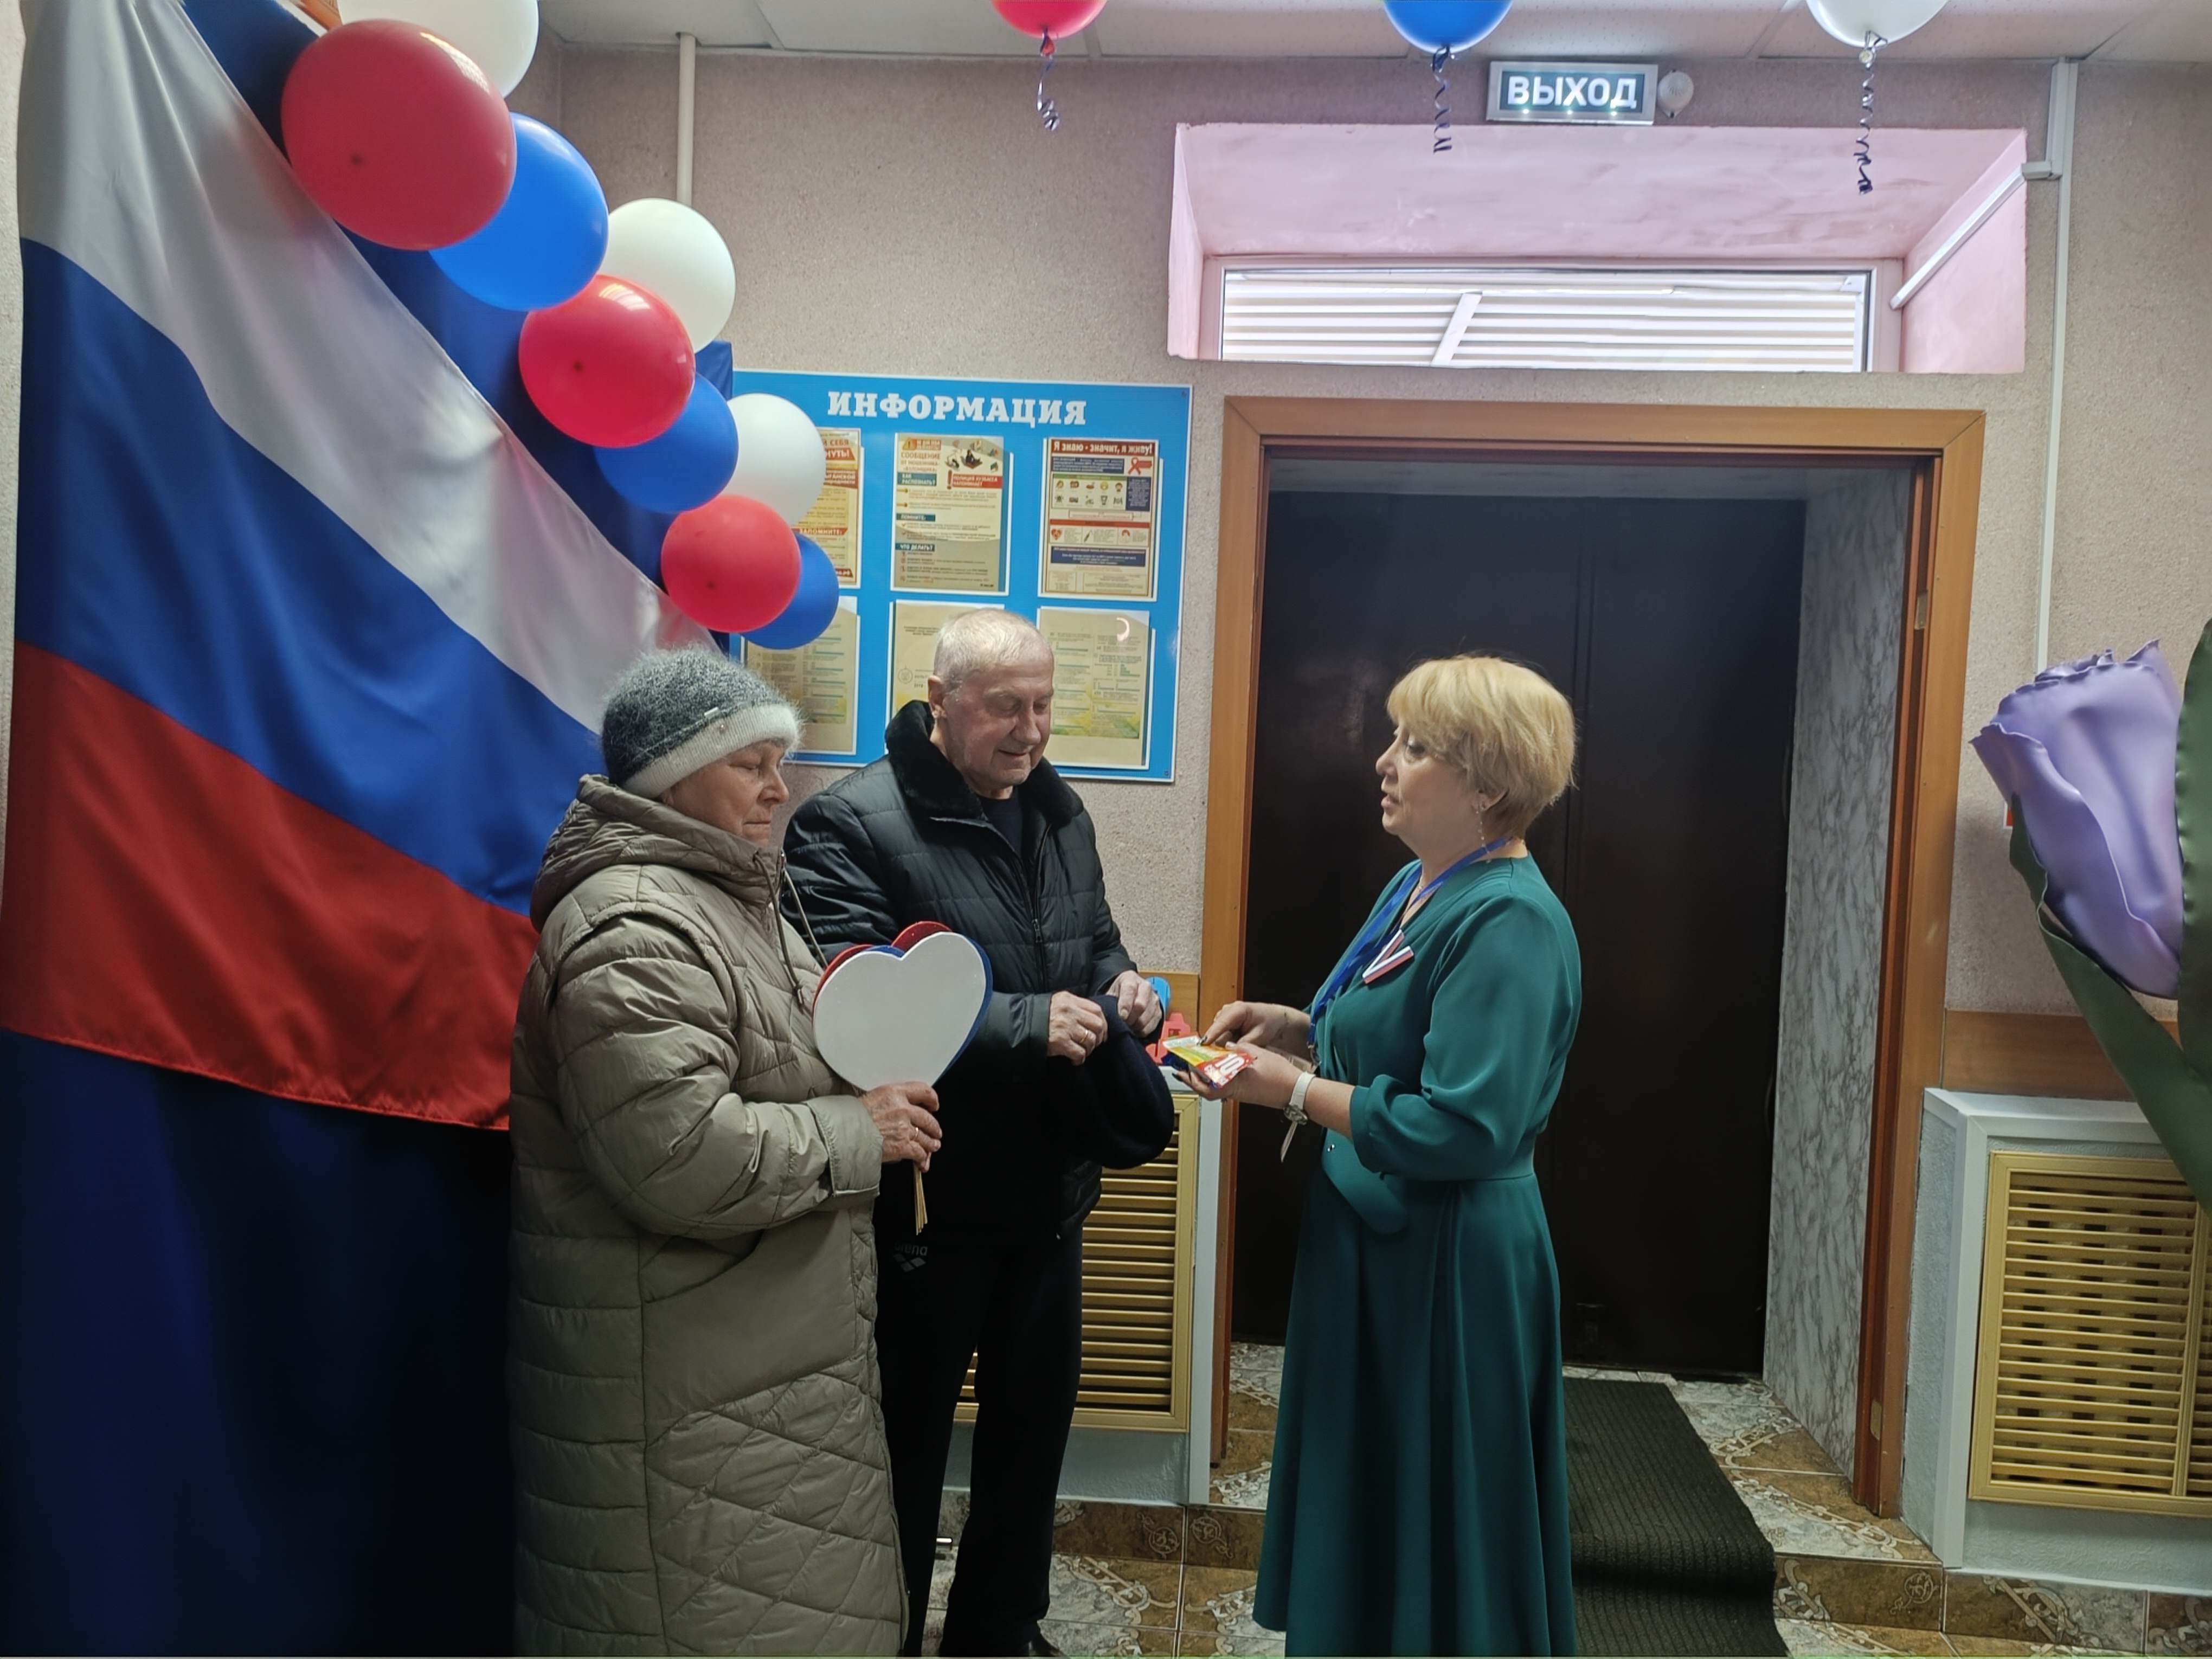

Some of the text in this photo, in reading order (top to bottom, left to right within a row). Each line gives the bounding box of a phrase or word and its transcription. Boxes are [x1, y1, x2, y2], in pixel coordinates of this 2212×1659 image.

[1507, 76, 1637, 109] ВЫХОД
[828, 391, 1086, 428] ИНФОРМАЦИЯ
[901, 452, 940, 460] СООБЩЕНИЕ
[1054, 441, 1060, 451] Я
[1062, 443, 1083, 452] знаю
[1090, 443, 1120, 455] значит,
[1121, 445, 1127, 453] я
[1128, 443, 1153, 456] живу!
